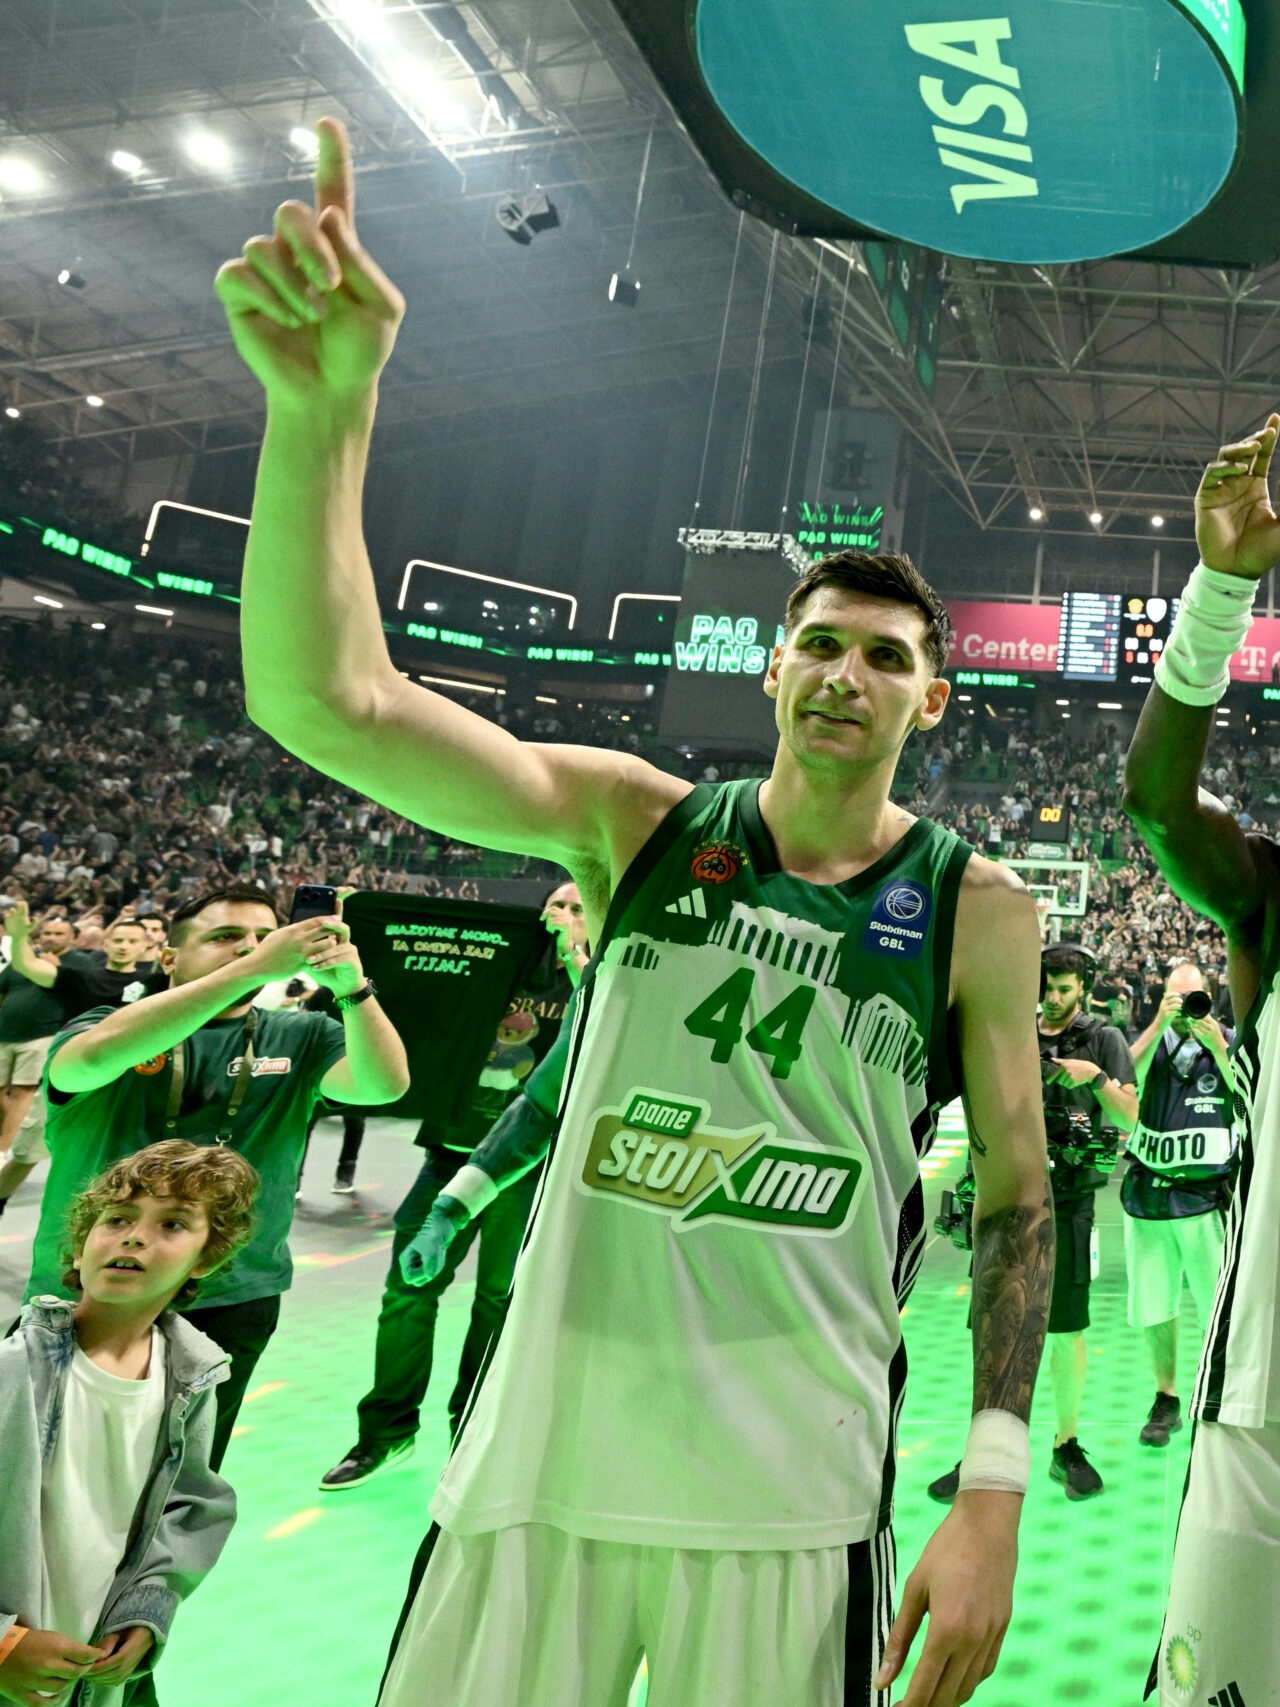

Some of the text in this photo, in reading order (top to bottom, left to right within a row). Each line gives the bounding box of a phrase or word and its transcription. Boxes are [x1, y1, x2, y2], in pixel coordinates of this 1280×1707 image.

[904, 18, 1038, 214] VISA
[798, 530, 873, 546] PAO WINS!
[43, 528, 131, 576] PAO WINS!
[157, 572, 213, 595] WINS!
[407, 623, 483, 649] PAO WINS!
[691, 614, 758, 646] PAO
[527, 647, 594, 662] PAO WINS!
[634, 653, 659, 666] PAO
[675, 641, 766, 675] WINS
[963, 633, 1059, 662] Center
[956, 671, 1019, 687] PAO WINS!
[1040, 807, 1061, 822] 00
[870, 921, 923, 940] Stoiximan
[879, 936, 905, 951] GBL
[684, 967, 816, 1079] 44
[629, 1100, 692, 1130] pame
[1138, 1131, 1206, 1165] PHOTO
[1187, 1620, 1202, 1644] bp
